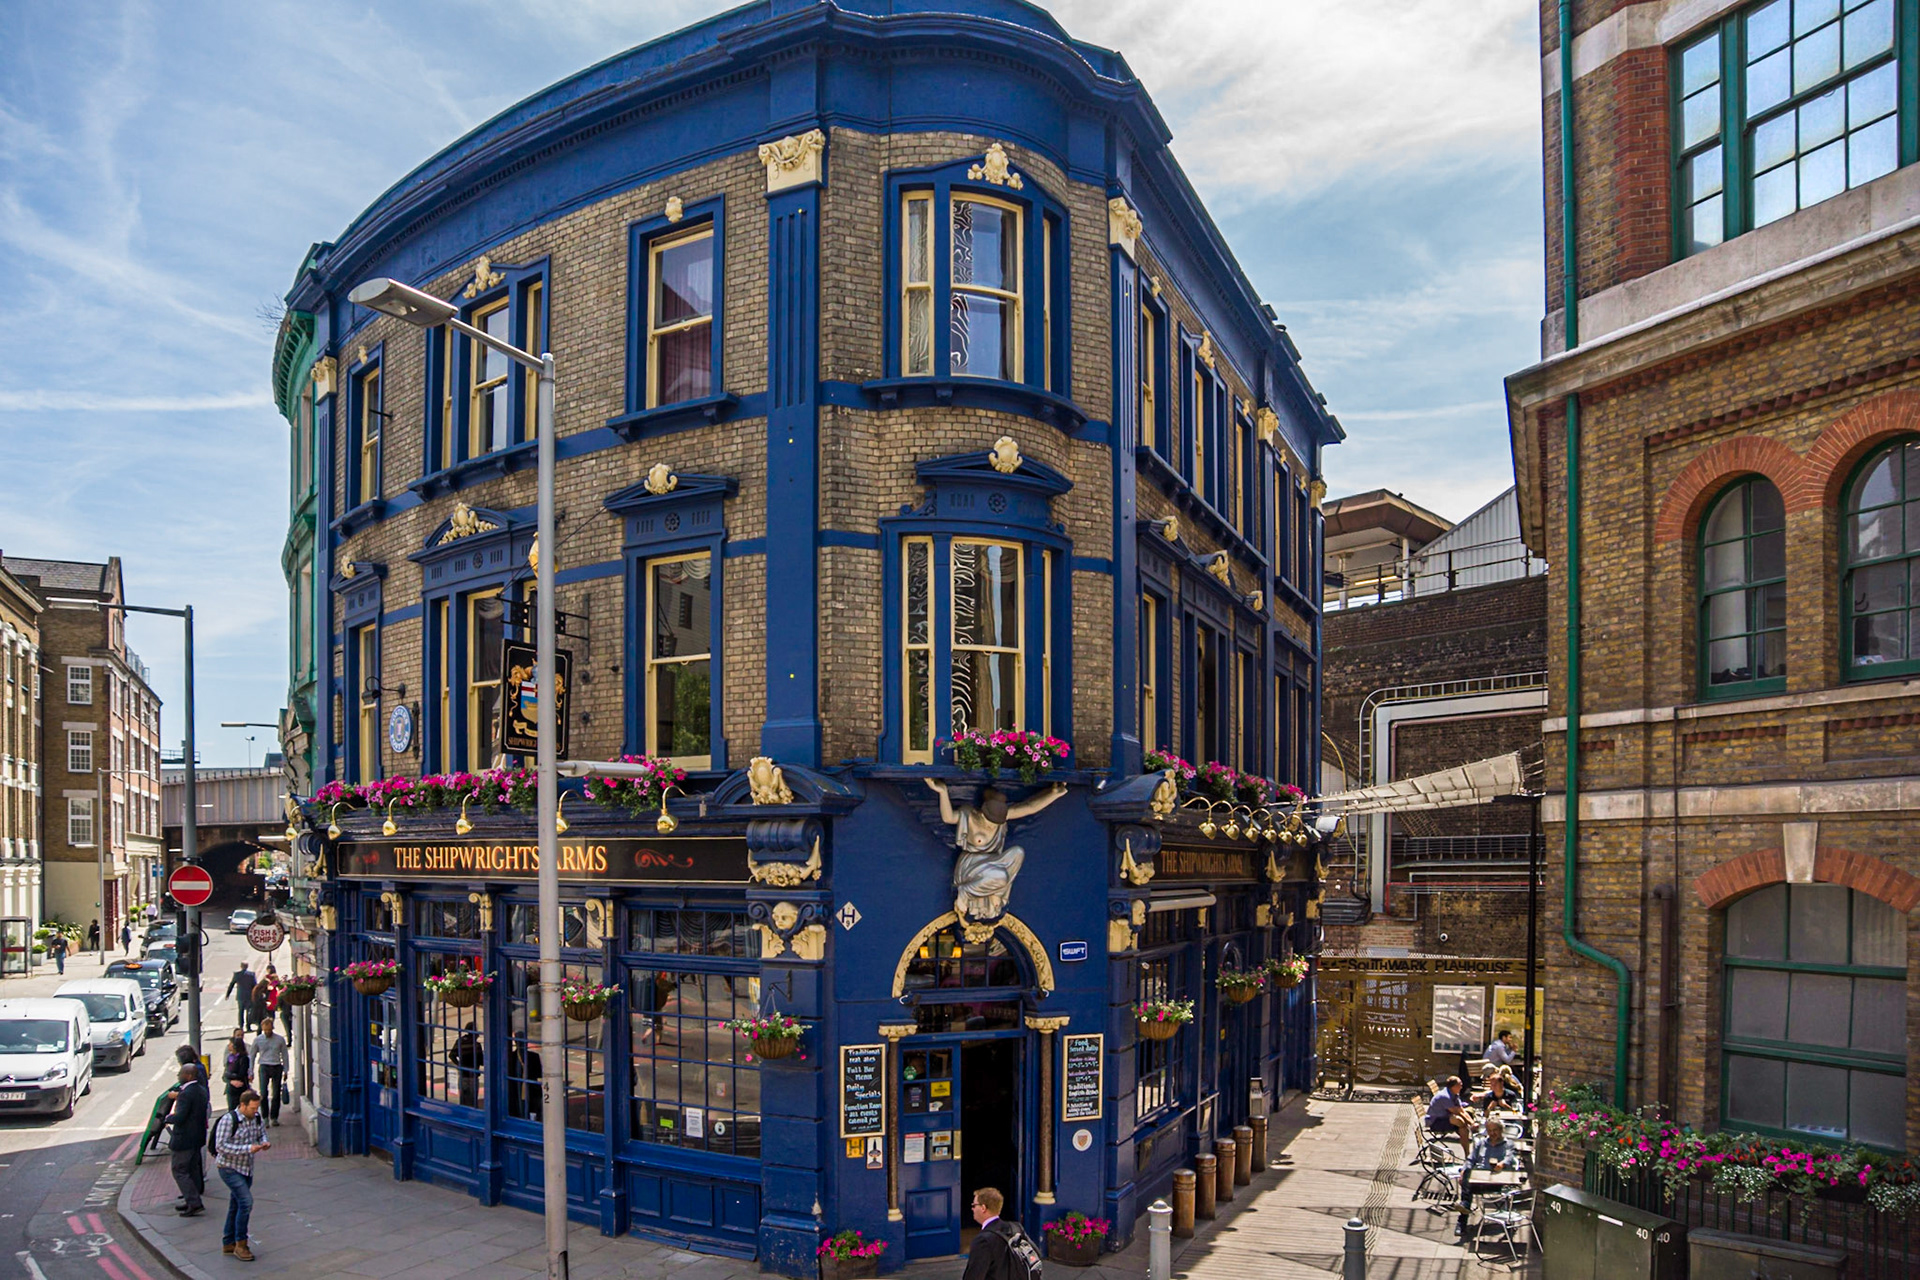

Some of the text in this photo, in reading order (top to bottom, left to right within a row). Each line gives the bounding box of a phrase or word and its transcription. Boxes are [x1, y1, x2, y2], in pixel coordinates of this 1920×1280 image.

[394, 847, 421, 869] THE
[425, 846, 539, 871] SHIPWRIGHTS
[1161, 851, 1178, 873] THE
[842, 908, 855, 923] H
[1434, 960, 1514, 973] PLAYHOUSE
[1636, 1228, 1648, 1240] 40
[1657, 1232, 1670, 1243] 40
